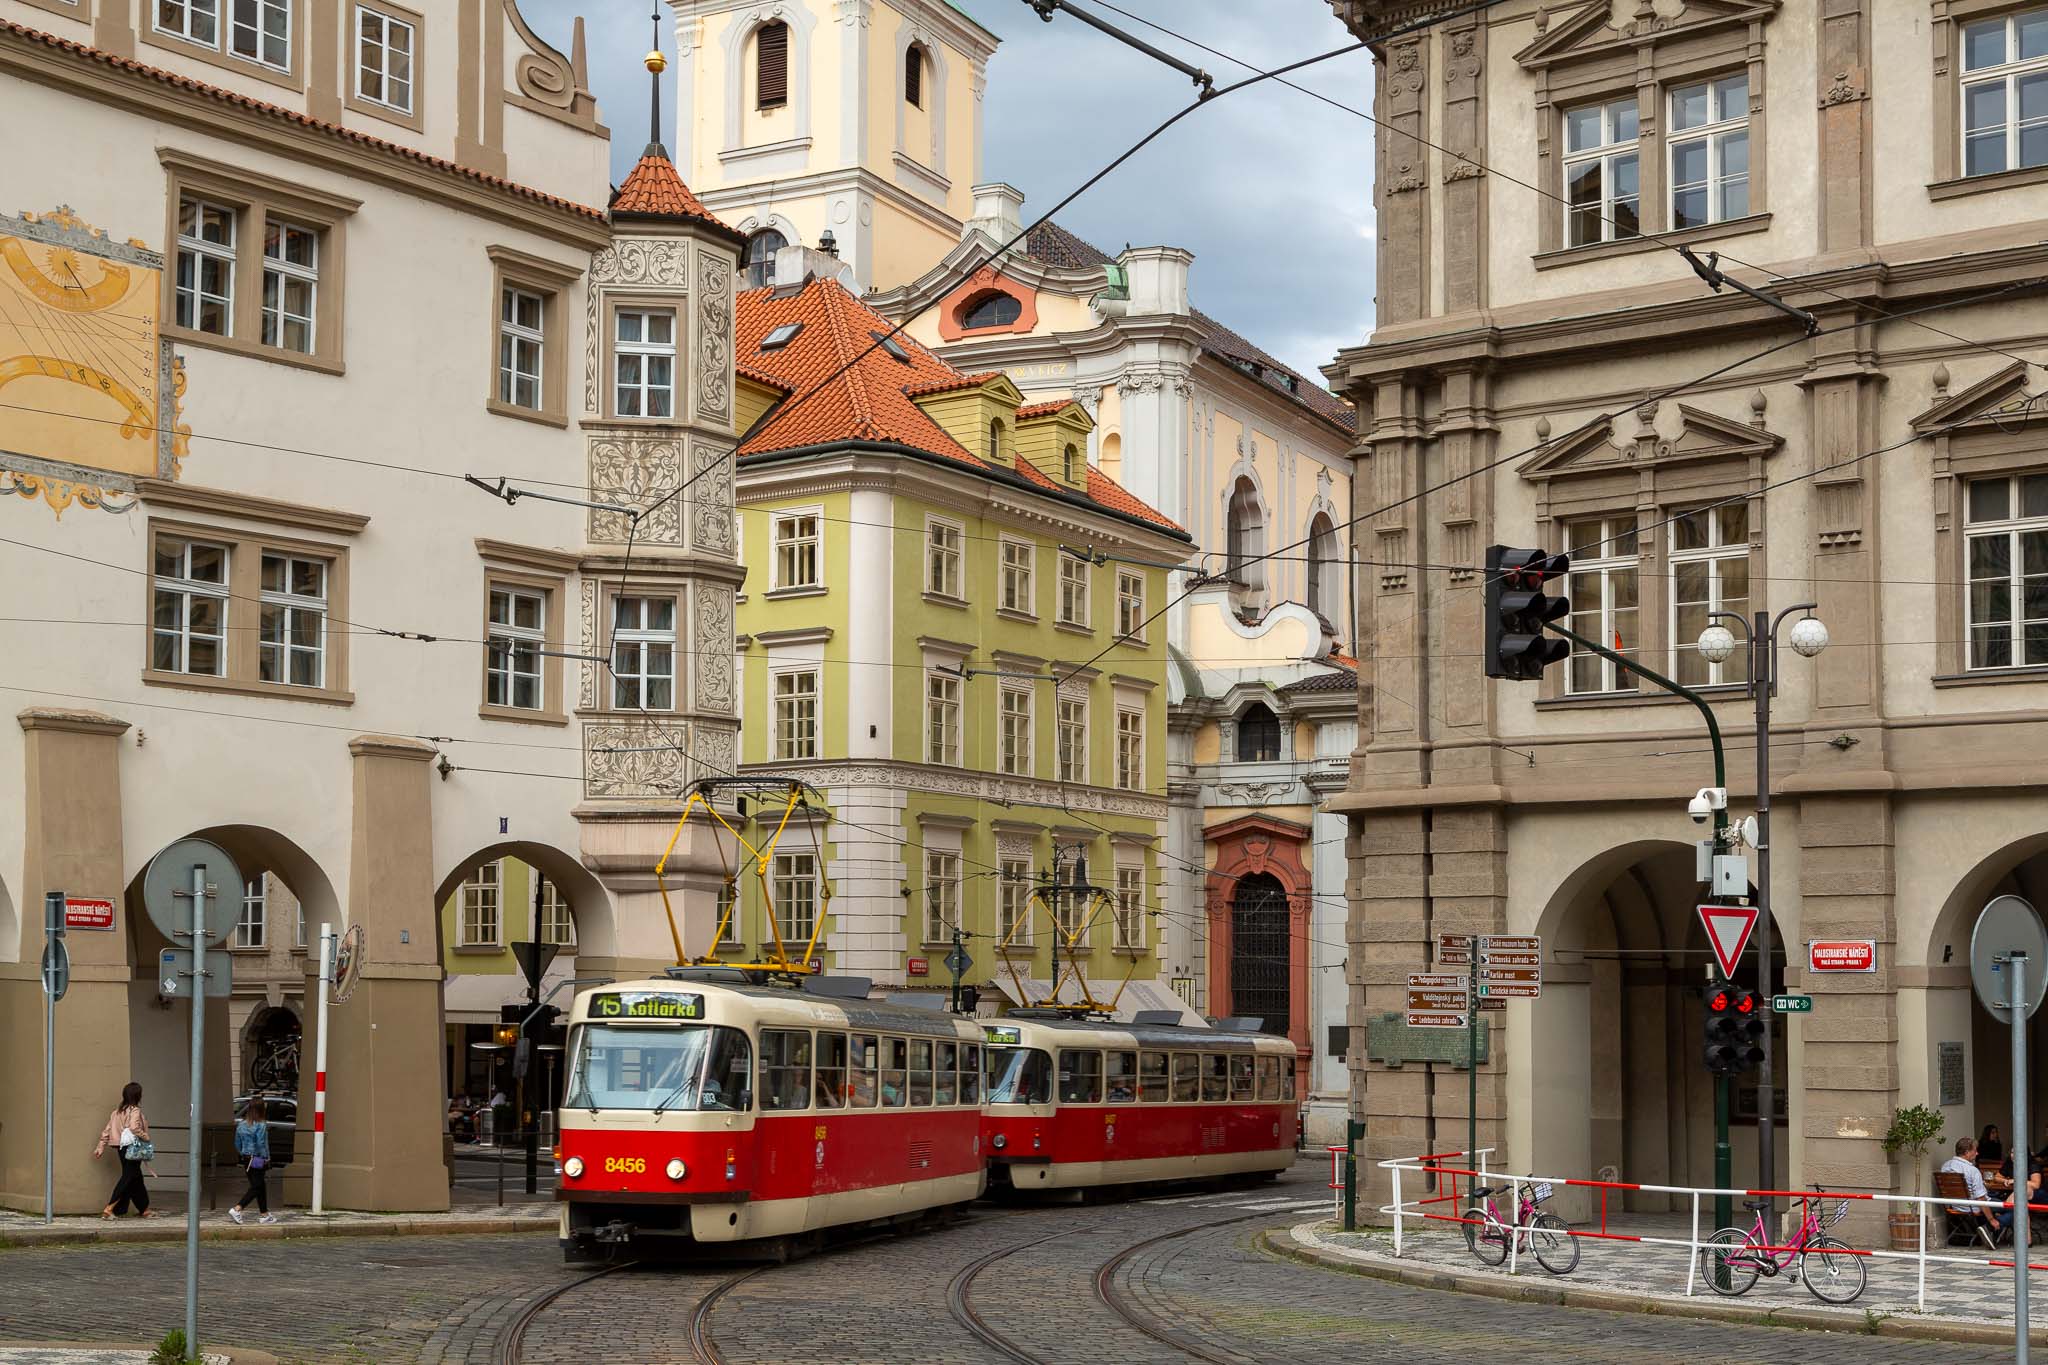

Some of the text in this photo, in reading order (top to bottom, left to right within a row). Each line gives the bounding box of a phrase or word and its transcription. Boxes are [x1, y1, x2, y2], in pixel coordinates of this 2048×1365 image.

[1814, 946, 1869, 958] MALOSTRANSKÉ NÁMĚSTÍ
[1512, 954, 1529, 964] zahrada
[1504, 972, 1515, 980] most
[597, 998, 620, 1015] 15
[1788, 999, 1800, 1009] WC
[1441, 1015, 1457, 1026] zahrada
[604, 1157, 646, 1174] 8456
